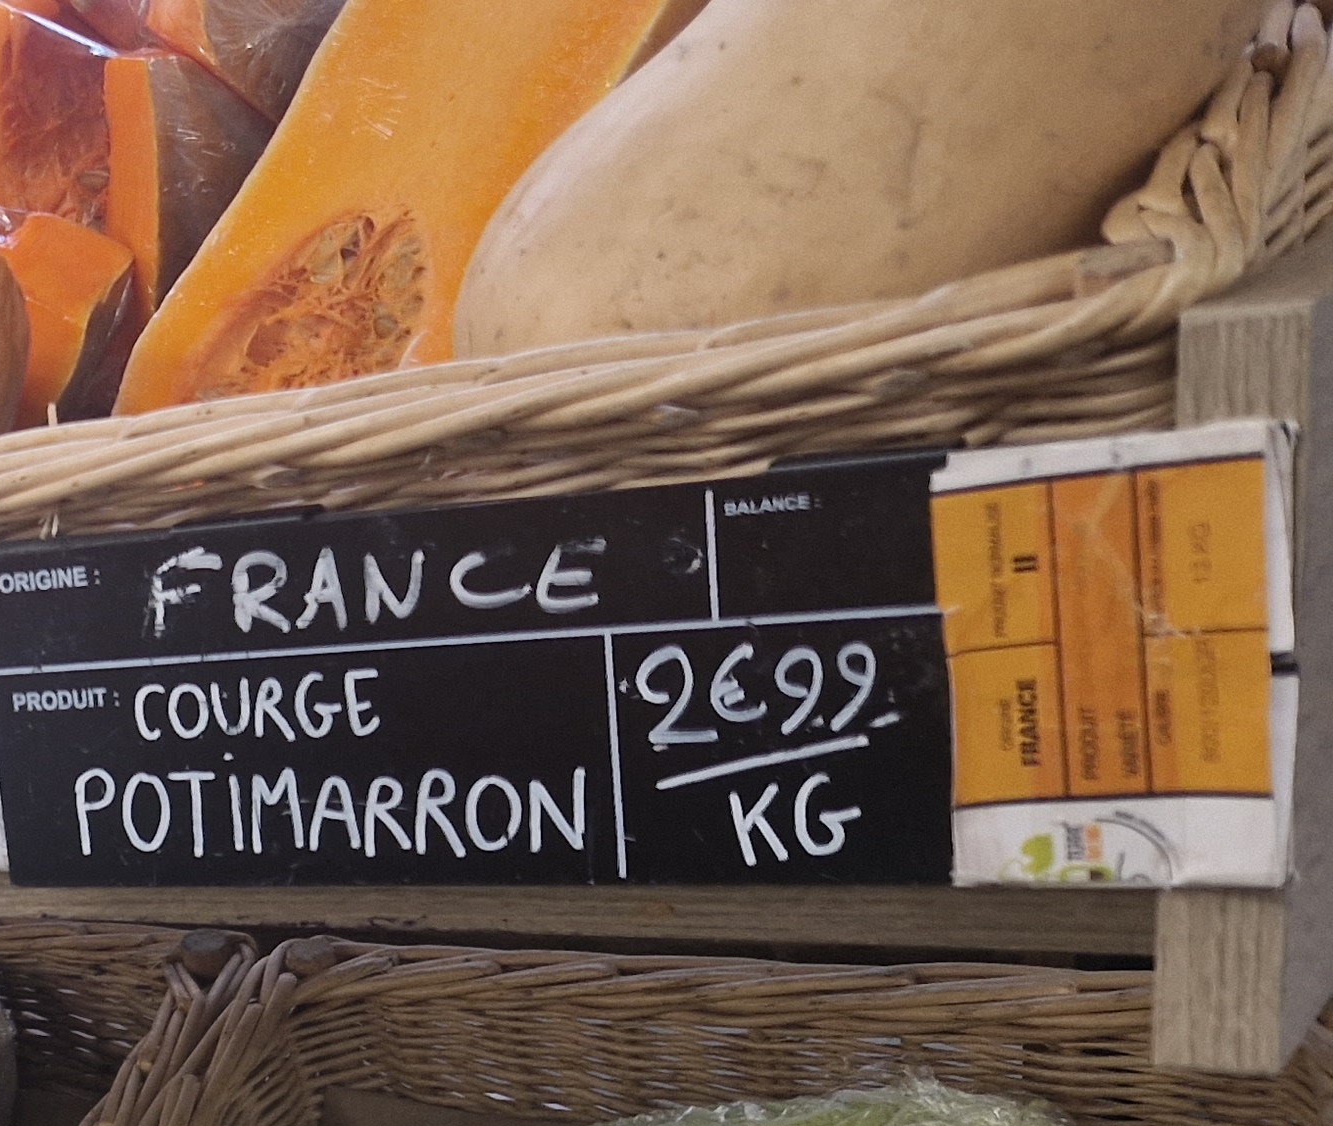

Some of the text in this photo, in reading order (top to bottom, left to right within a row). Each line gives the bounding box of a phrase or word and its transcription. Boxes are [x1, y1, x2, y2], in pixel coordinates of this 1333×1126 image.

[724, 494, 811, 517] BALANCE
[143, 537, 608, 639] FRANCE
[12, 667, 381, 744] PRODUIT COURGE
[1015, 679, 1040, 768] FRANCE
[74, 753, 588, 861] POTIMARRON
[729, 773, 863, 868] KG
